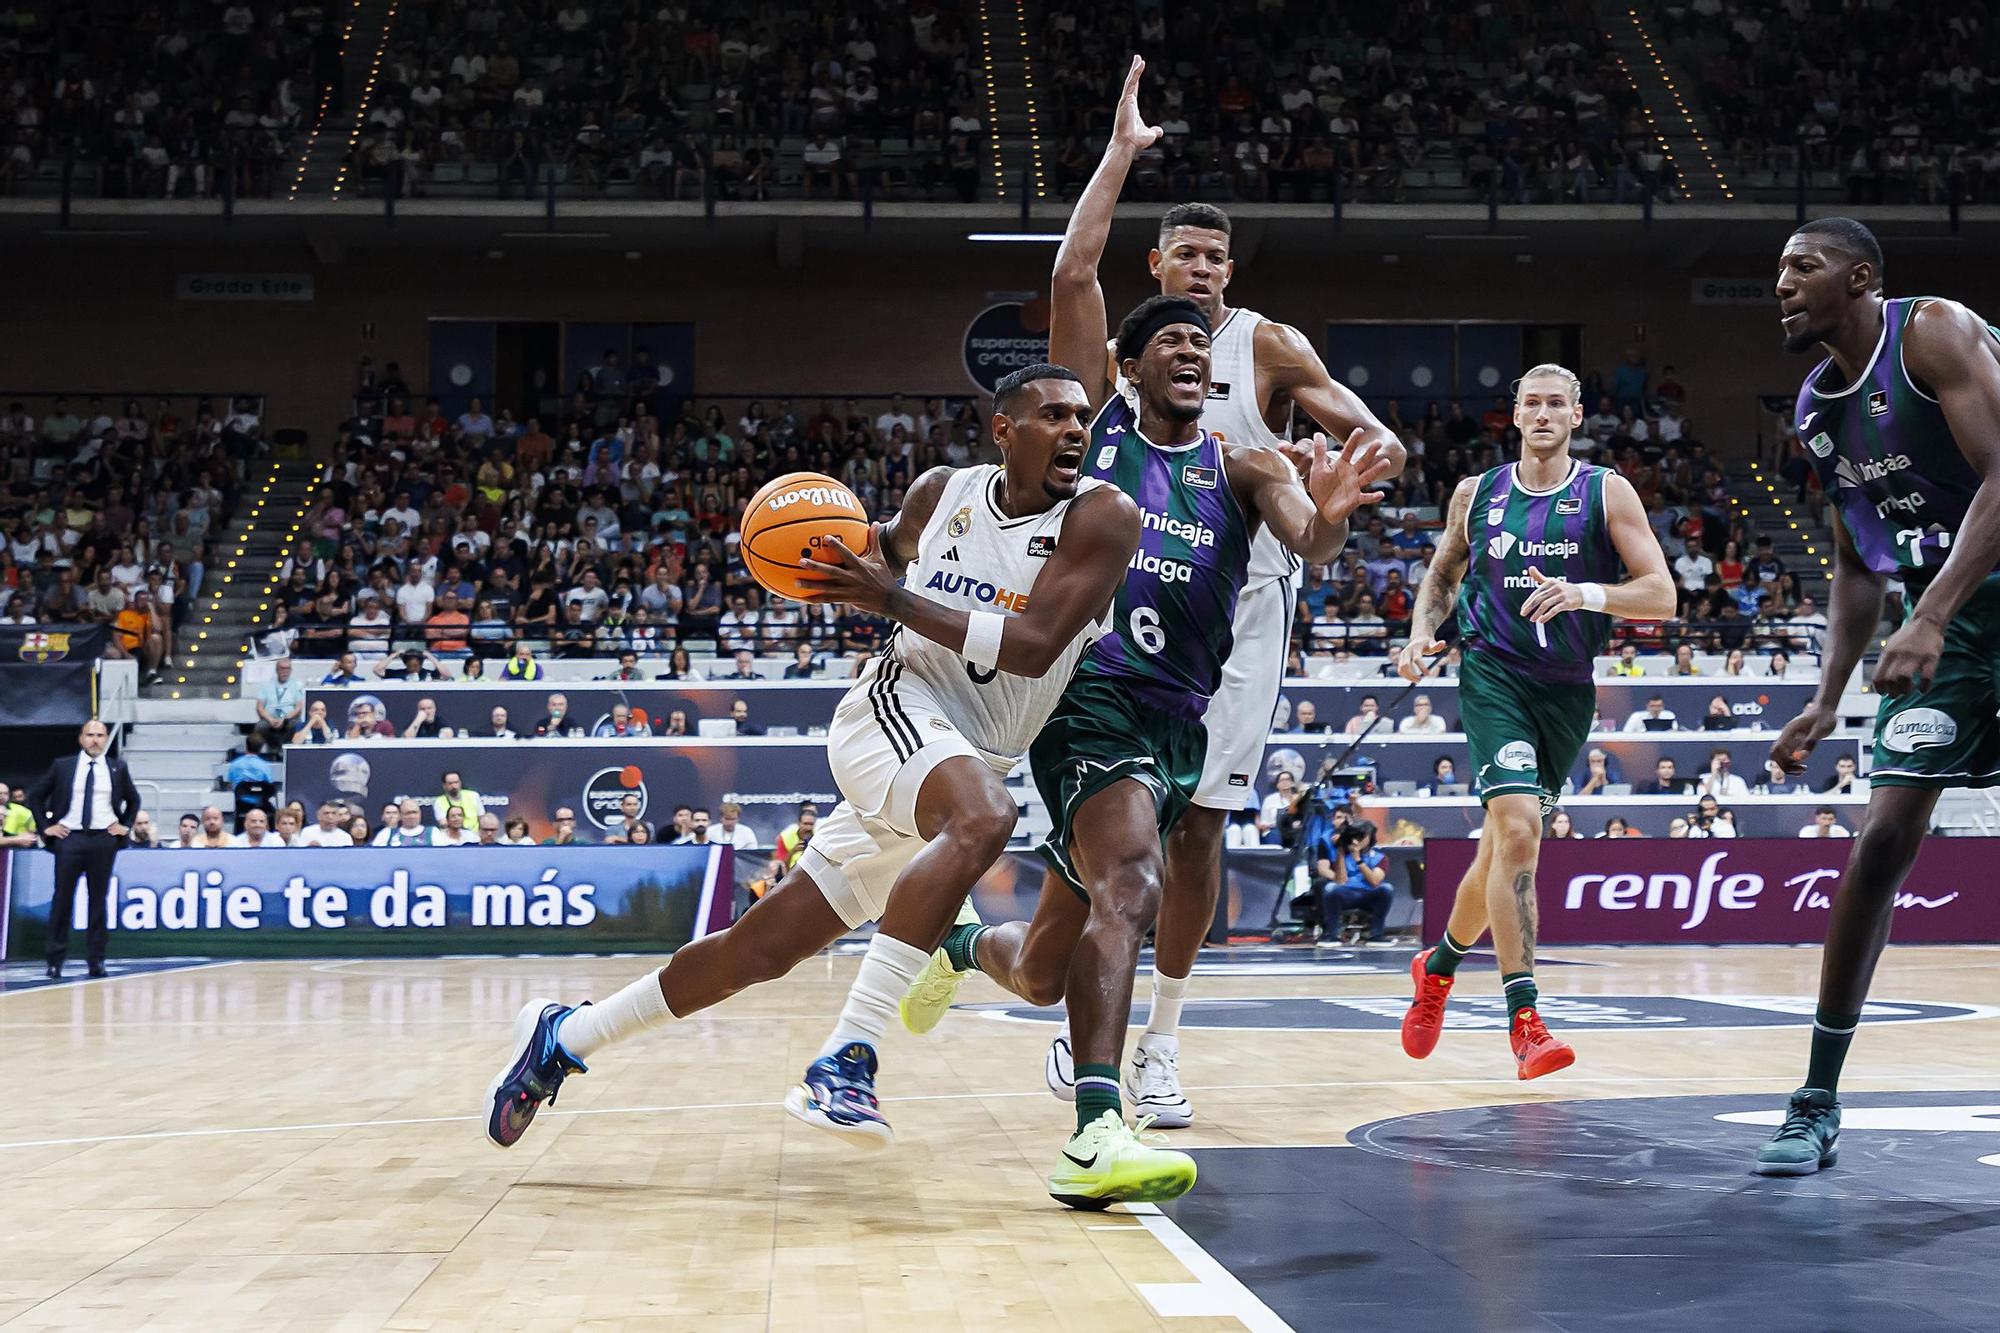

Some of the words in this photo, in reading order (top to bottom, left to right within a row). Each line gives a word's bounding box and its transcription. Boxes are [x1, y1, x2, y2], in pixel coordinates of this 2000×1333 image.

[768, 487, 855, 512] Wilson
[1518, 538, 1579, 560] Unicaja
[1130, 606, 1166, 654] 6
[284, 877, 347, 929] te
[370, 869, 446, 928] da
[471, 868, 597, 926] más
[1564, 851, 1765, 930] renfe
